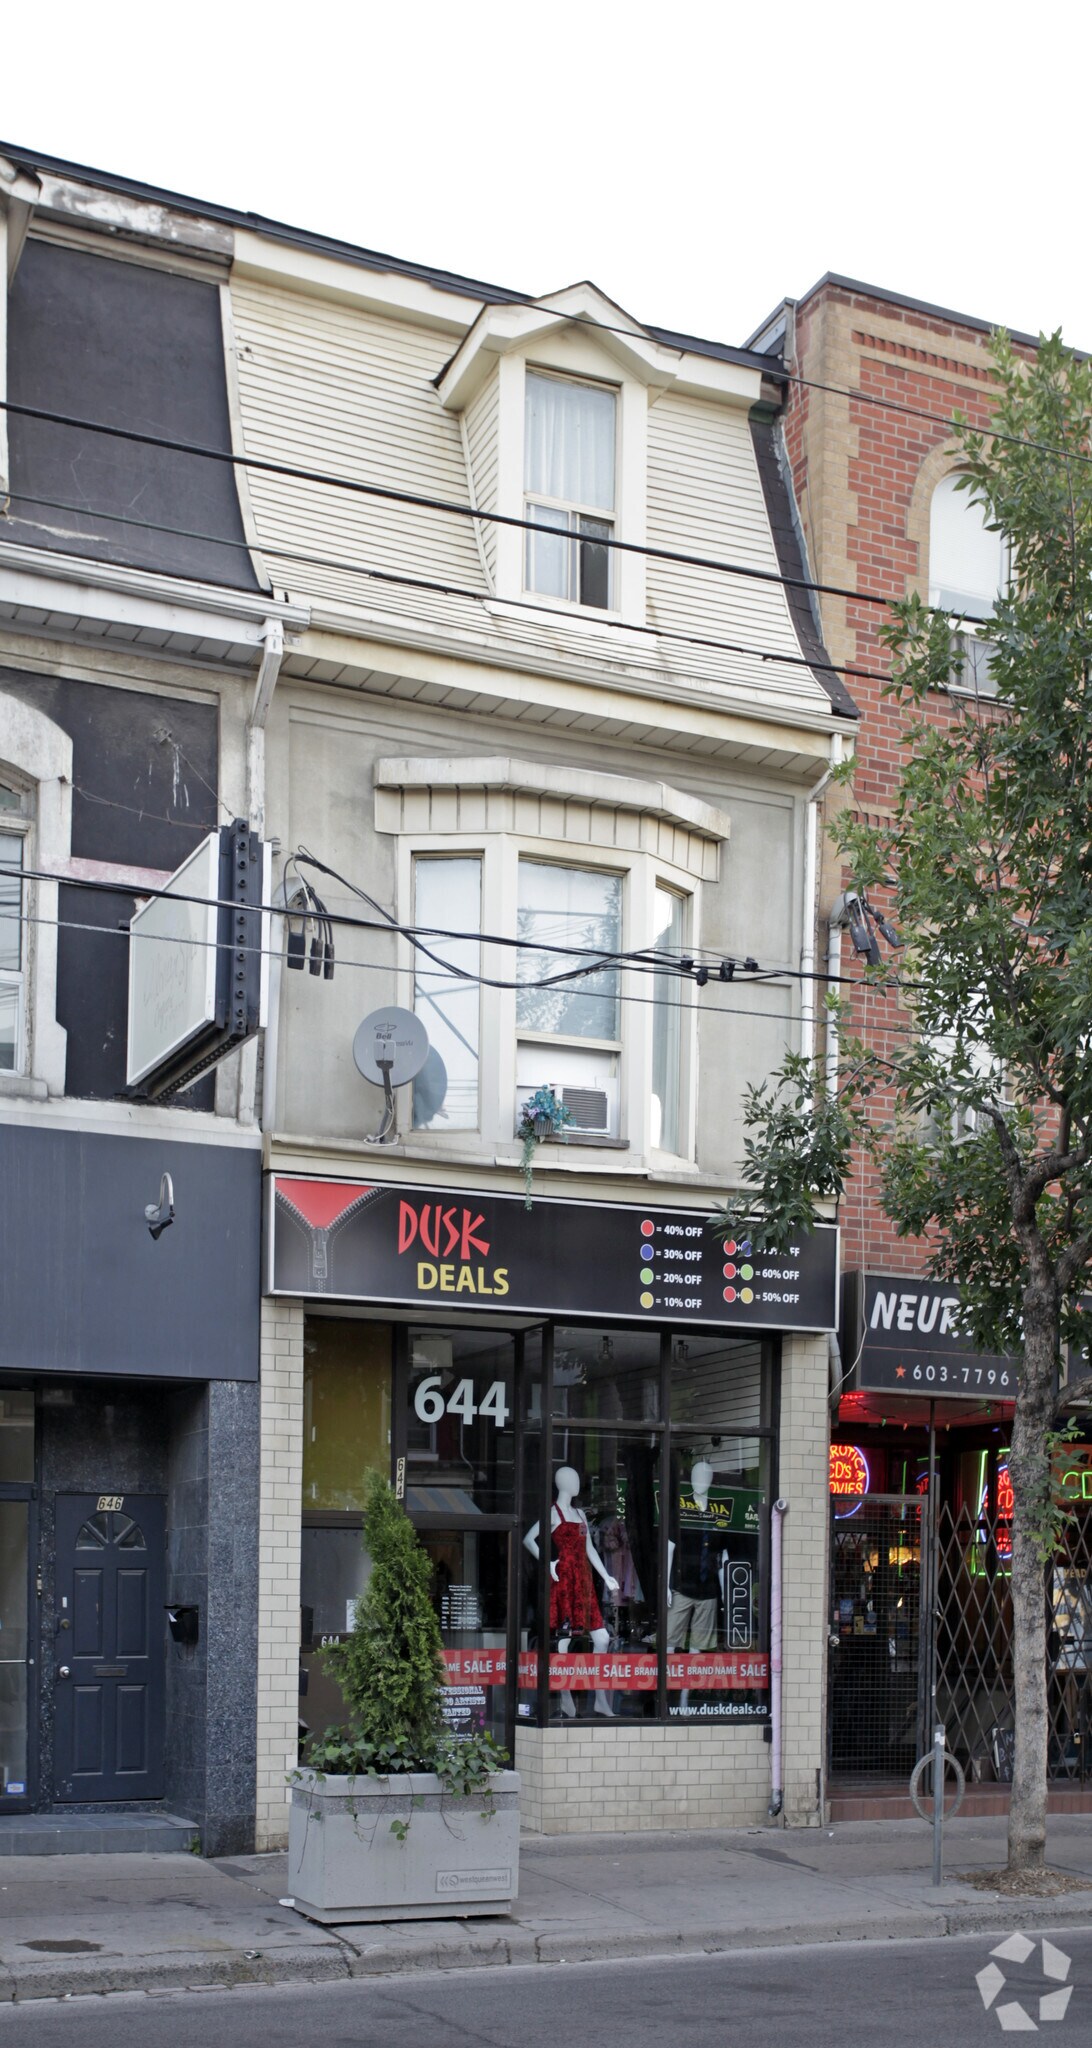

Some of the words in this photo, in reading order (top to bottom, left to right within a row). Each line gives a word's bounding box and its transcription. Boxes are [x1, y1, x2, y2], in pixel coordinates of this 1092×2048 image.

[375, 1032, 392, 1040] Bell
[398, 1199, 491, 1260] DUSK
[664, 1225, 684, 1236] 40%
[685, 1227, 703, 1237] OFF
[664, 1249, 684, 1260] 30%
[685, 1251, 702, 1261] OFF
[417, 1262, 510, 1296] DEALS
[664, 1273, 684, 1284] 20%
[685, 1275, 702, 1285] OFF
[762, 1268, 781, 1279] 60%
[782, 1270, 800, 1280] OFF
[664, 1297, 684, 1308] 10%
[685, 1299, 702, 1309] OFF
[762, 1292, 781, 1303] 50%
[782, 1293, 800, 1304] OFF
[870, 1291, 976, 1339] NEUR
[912, 1364, 1010, 1386] 603-7796
[414, 1376, 510, 1428] 644
[98, 1497, 121, 1510] 646
[732, 1566, 749, 1645] OPEN
[464, 1660, 493, 1674] SALE
[576, 1666, 600, 1676] NAME
[603, 1664, 632, 1678] SALE
[687, 1666, 714, 1675] BRAND
[714, 1666, 737, 1675] NAME
[740, 1664, 767, 1677] SALE
[669, 1703, 768, 1716] www.duskdeals.ca
